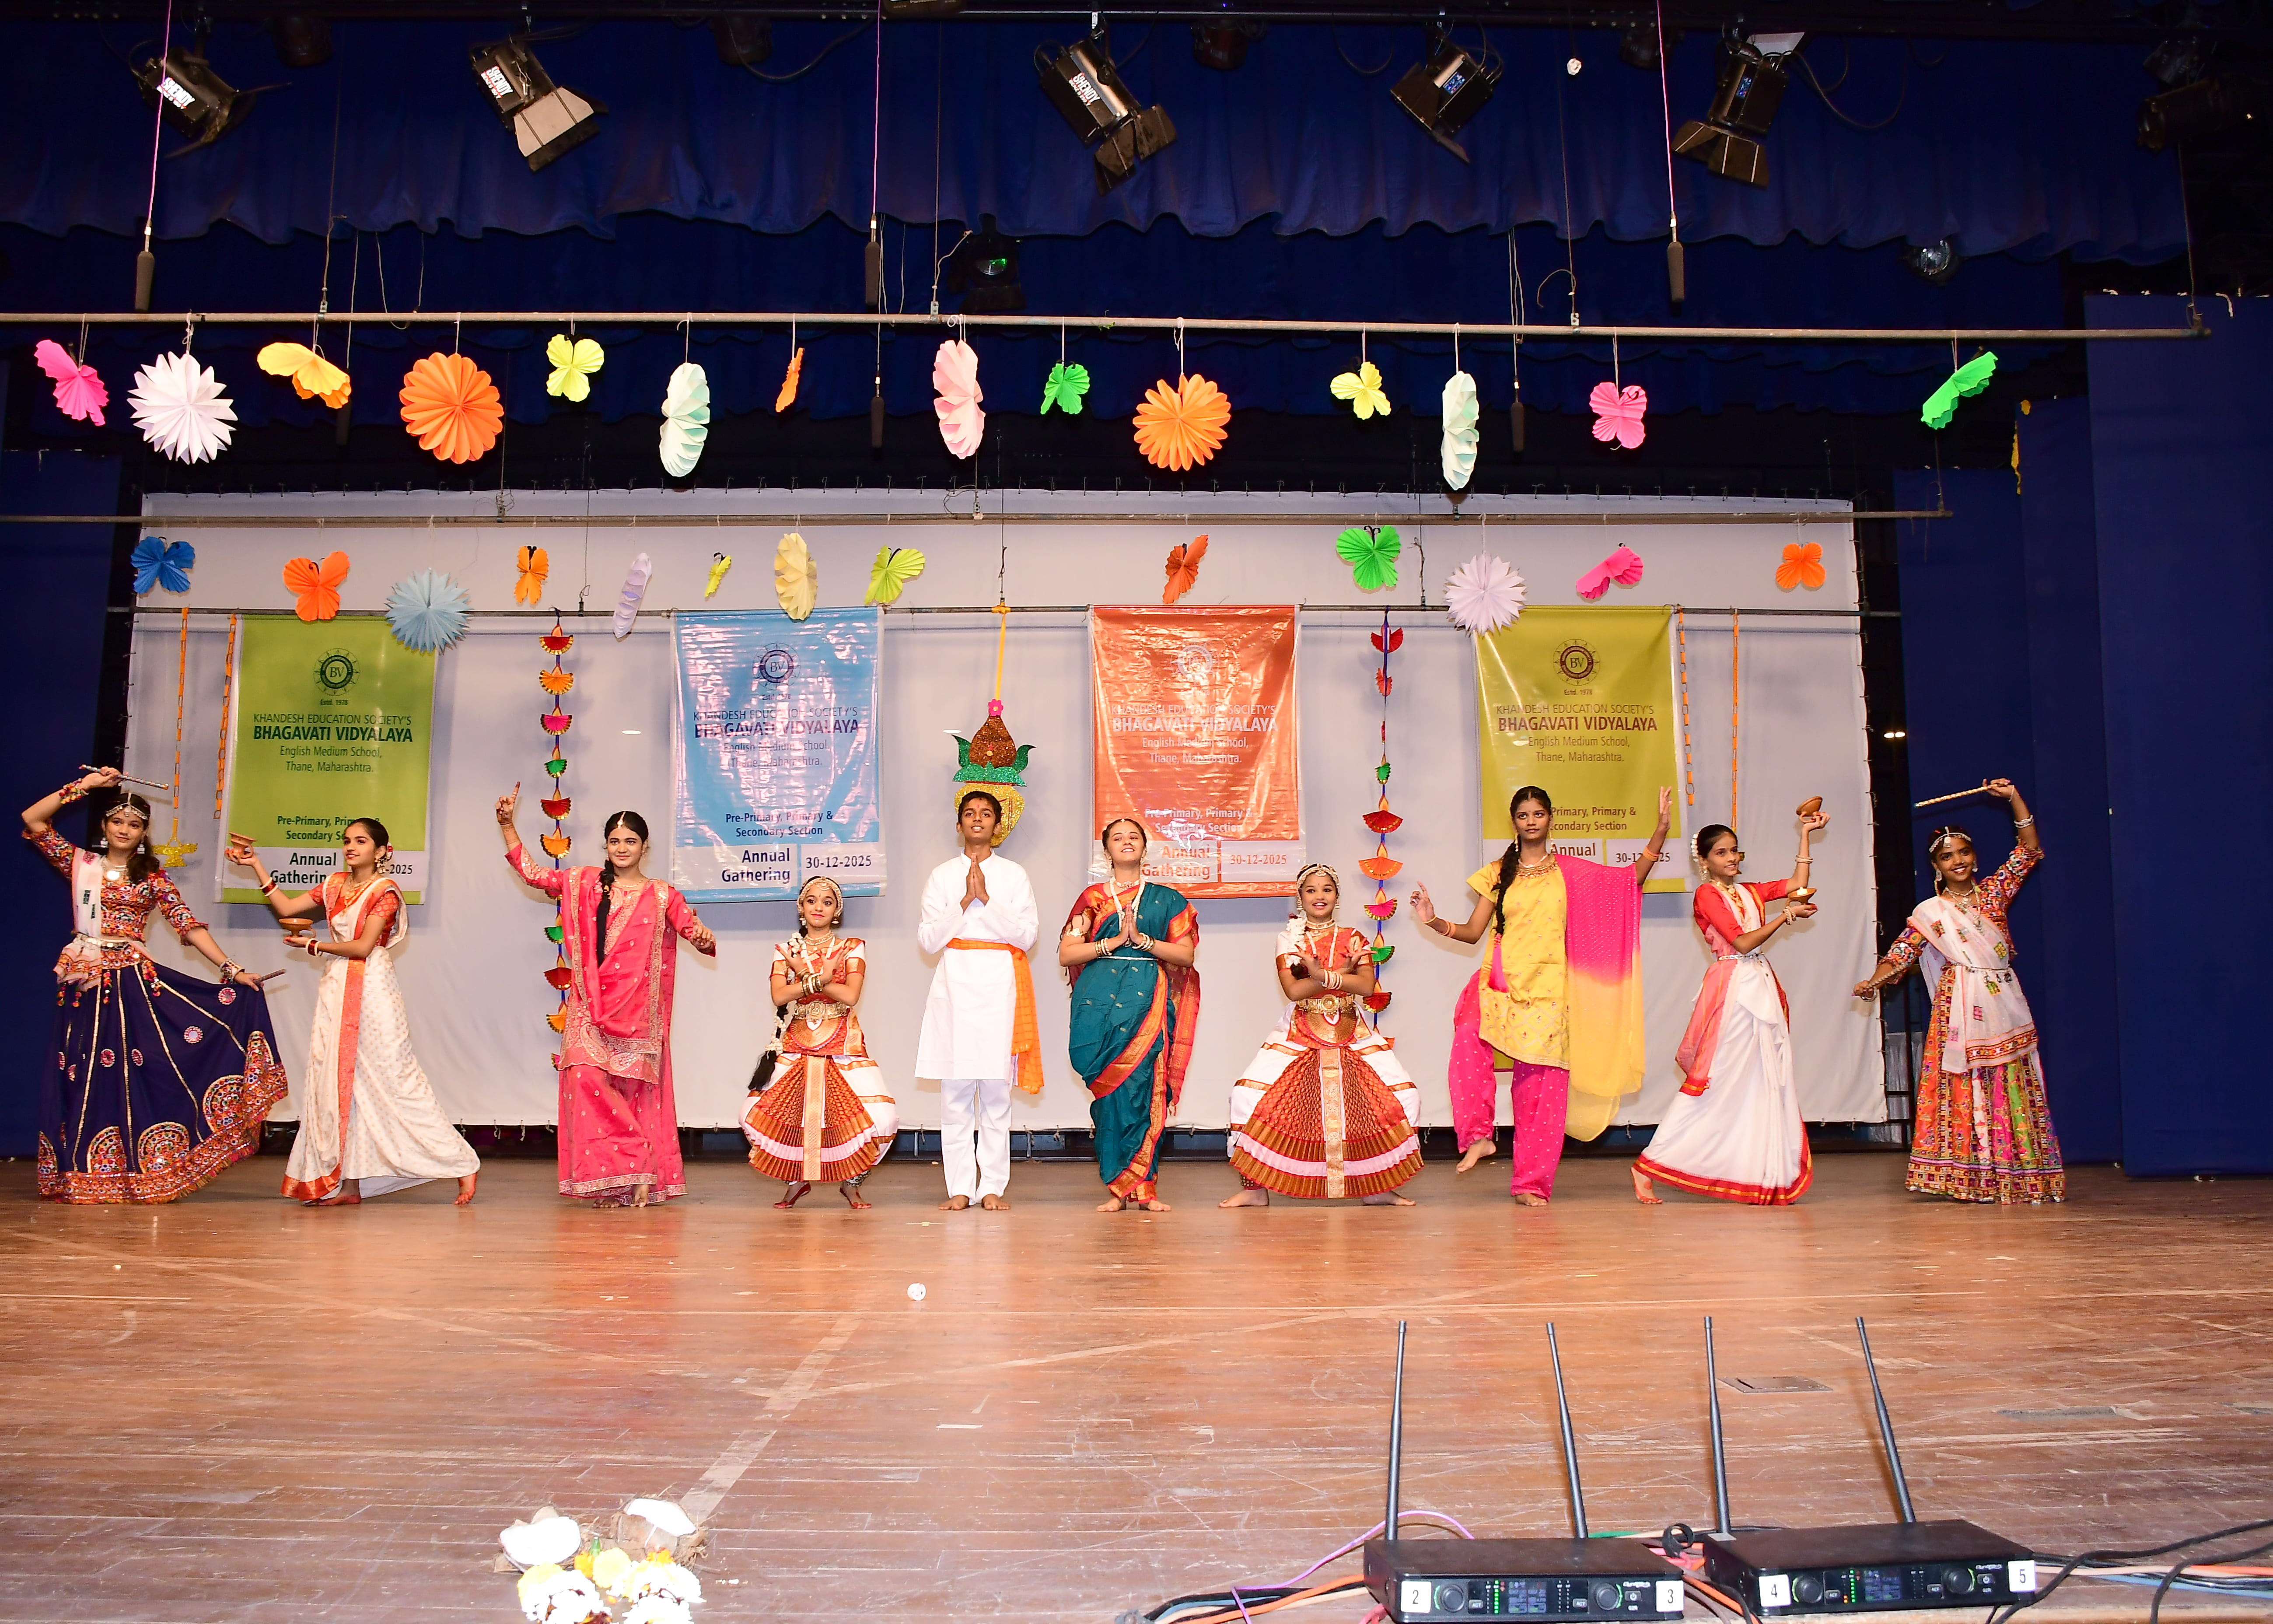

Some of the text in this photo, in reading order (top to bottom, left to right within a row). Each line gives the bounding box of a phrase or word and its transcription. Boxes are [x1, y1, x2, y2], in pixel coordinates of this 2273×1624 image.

[1570, 657, 1584, 668] BV
[329, 667, 345, 678] BV
[1496, 704, 1654, 714] KHANDESH EDUCATION SOCIETY'S
[253, 714, 304, 724] KHANDESH
[308, 714, 360, 724] EDUCATION
[1113, 717, 1278, 732] BHAGAVATI VIDYALAYA
[1498, 717, 1657, 731] BHAGAVATI VIDYALAYA
[253, 726, 413, 742] BHAGAVATI VIDYALAYA
[1143, 737, 1175, 749] English
[1528, 736, 1630, 749] English Medium School,
[280, 746, 382, 759] English Medium School,
[1150, 753, 1180, 764] Thane,
[1536, 752, 1624, 763] Thane, Maharashtra.
[286, 761, 374, 773] Thane, Maharashtra.
[826, 810, 833, 819] &
[1206, 808, 1243, 819] Primary
[1551, 806, 1636, 818] Primary, Primary &
[277, 816, 331, 828] Pre-Primary,
[1550, 821, 1627, 833] condary Section
[287, 830, 333, 842] Secondary
[736, 826, 822, 838] Secondary Section
[742, 848, 790, 863] Annual
[1551, 843, 1596, 856] Annual
[290, 852, 336, 866] Annual
[806, 855, 872, 869] 30-12-2025
[1230, 854, 1287, 864] 30-12-2025
[270, 870, 327, 884] Gatherin
[722, 867, 790, 884] Gathering
[1142, 863, 1210, 880] Gathering
[2019, 1568, 2026, 1584] 5
[1412, 1589, 1420, 1604] 2
[1667, 1589, 1674, 1604] 3
[1771, 1583, 1777, 1598] 4
